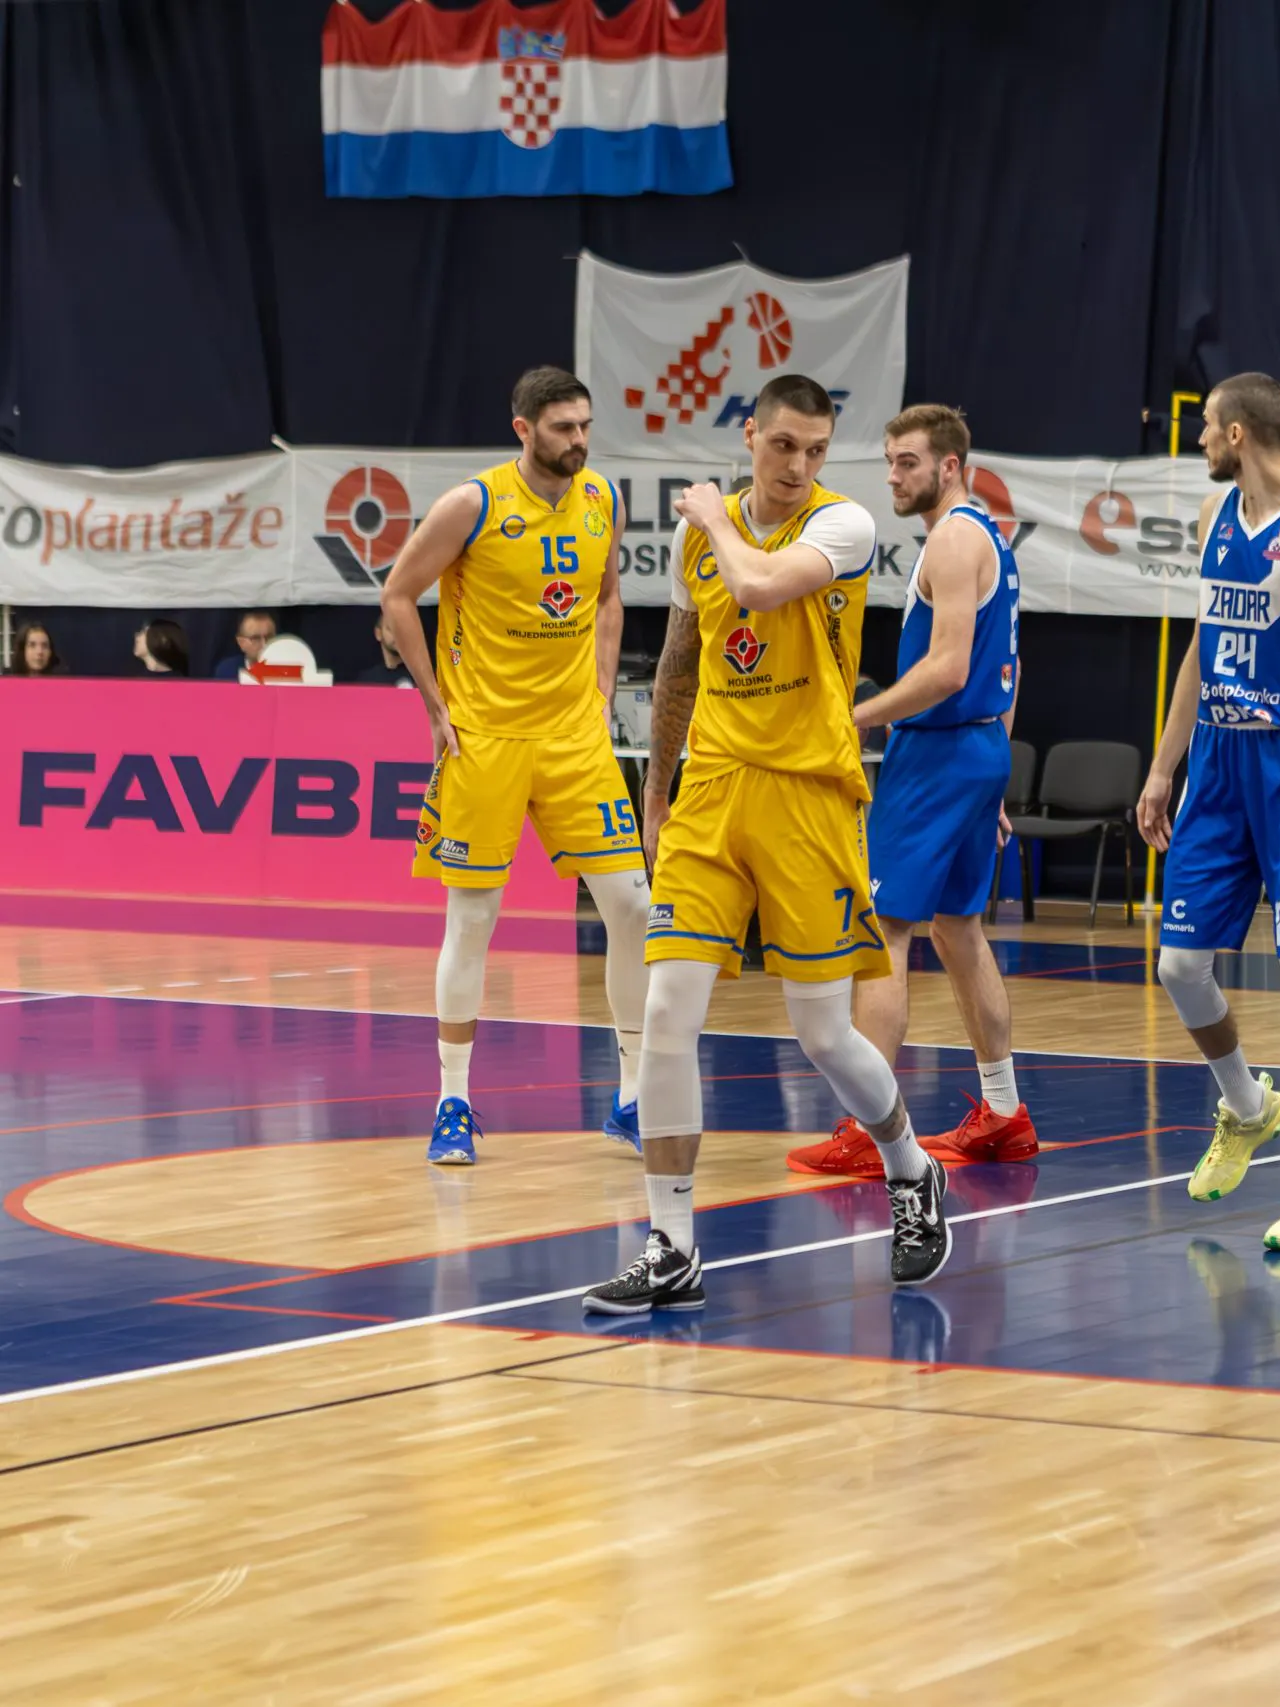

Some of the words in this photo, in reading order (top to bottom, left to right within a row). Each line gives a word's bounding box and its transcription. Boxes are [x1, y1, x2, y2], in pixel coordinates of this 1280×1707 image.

[0, 493, 283, 566] oplantaže
[540, 535, 579, 575] 15
[541, 620, 578, 629] HOLDING
[1207, 585, 1271, 624] ZADAR
[506, 629, 576, 639] VRIJEDNOSNICE
[1213, 631, 1257, 679] 24
[728, 674, 773, 687] HOLDING
[775, 676, 811, 695] OSIJEK
[19, 751, 435, 842] FAVBE
[597, 798, 636, 838] 15
[834, 887, 856, 933] 7
